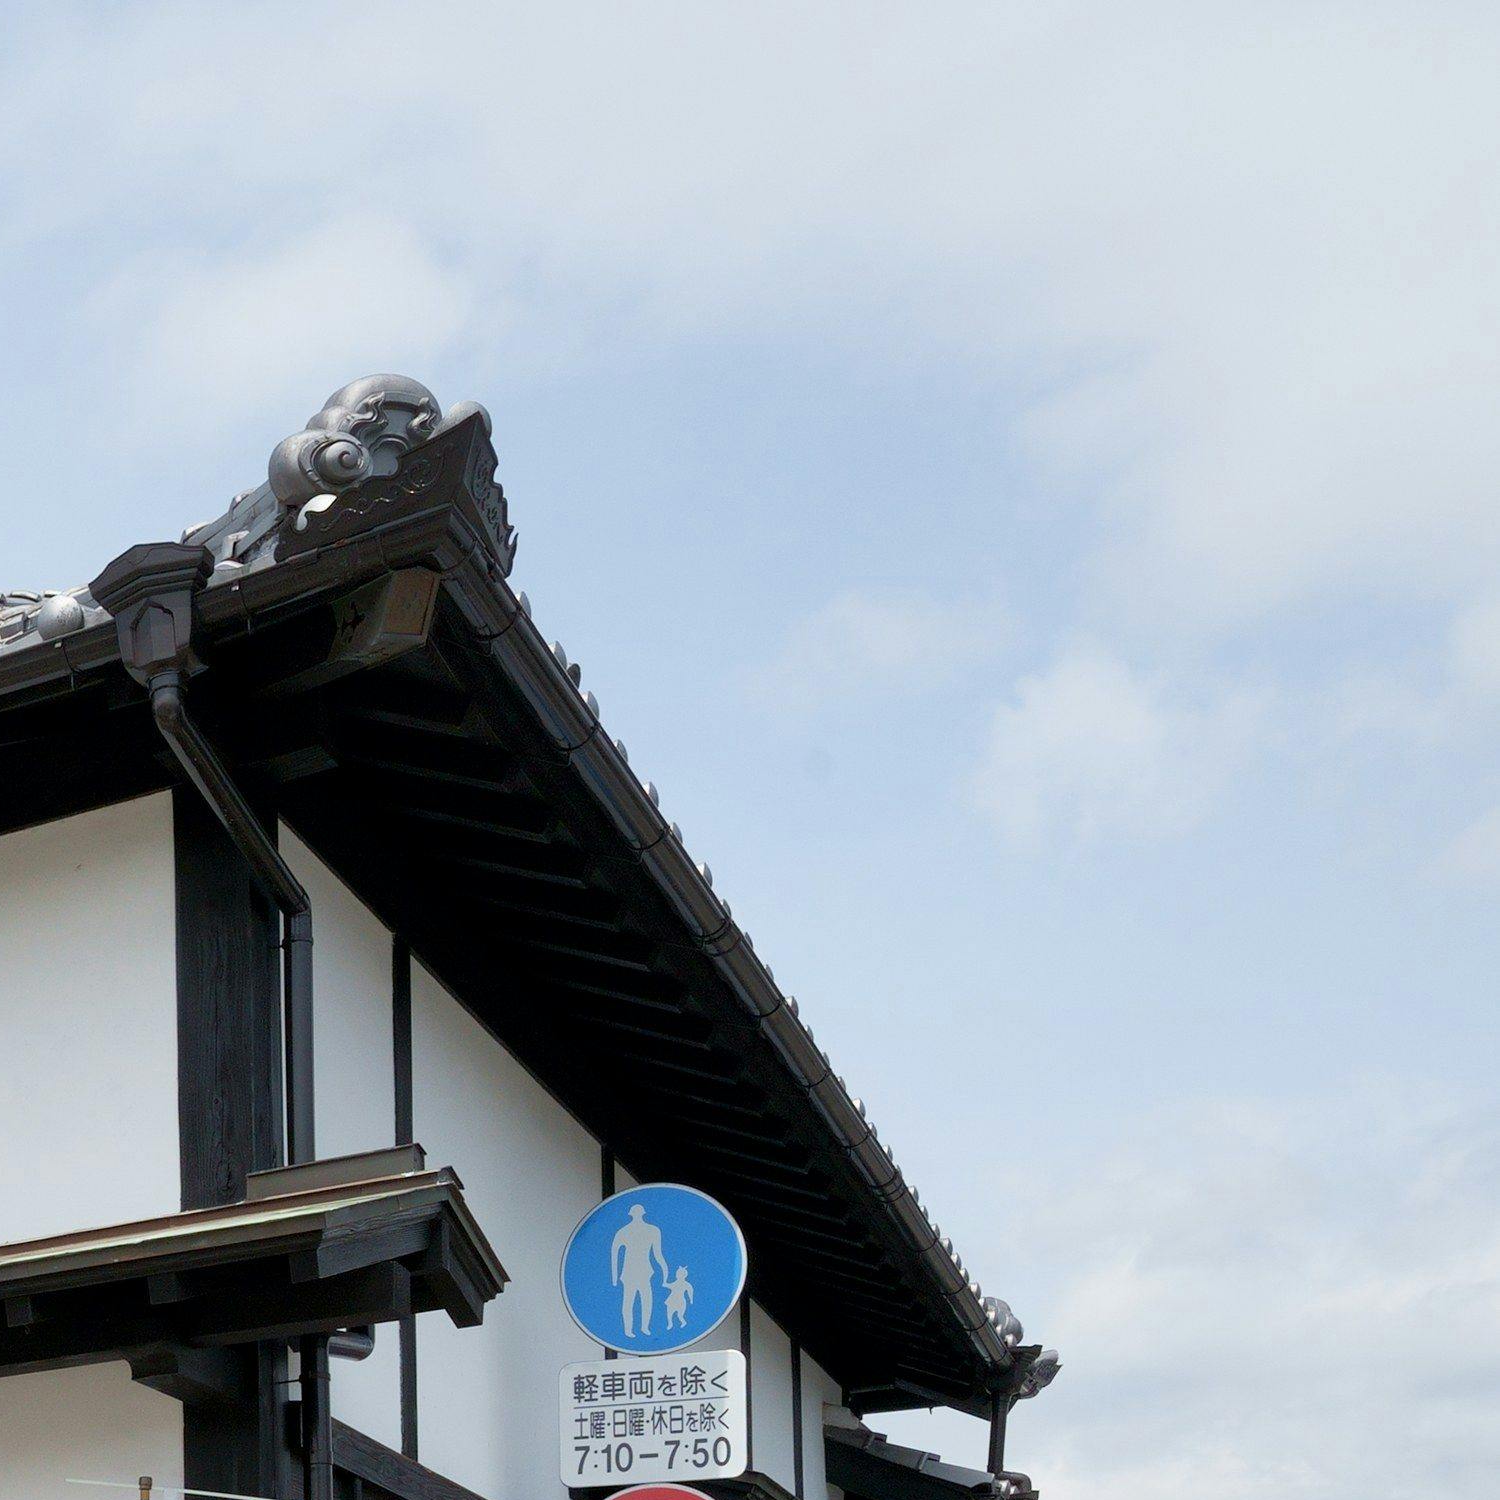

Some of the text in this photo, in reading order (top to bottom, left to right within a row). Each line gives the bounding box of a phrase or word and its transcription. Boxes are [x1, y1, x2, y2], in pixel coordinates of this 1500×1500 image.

[572, 1364, 730, 1404] 軽車両を除く
